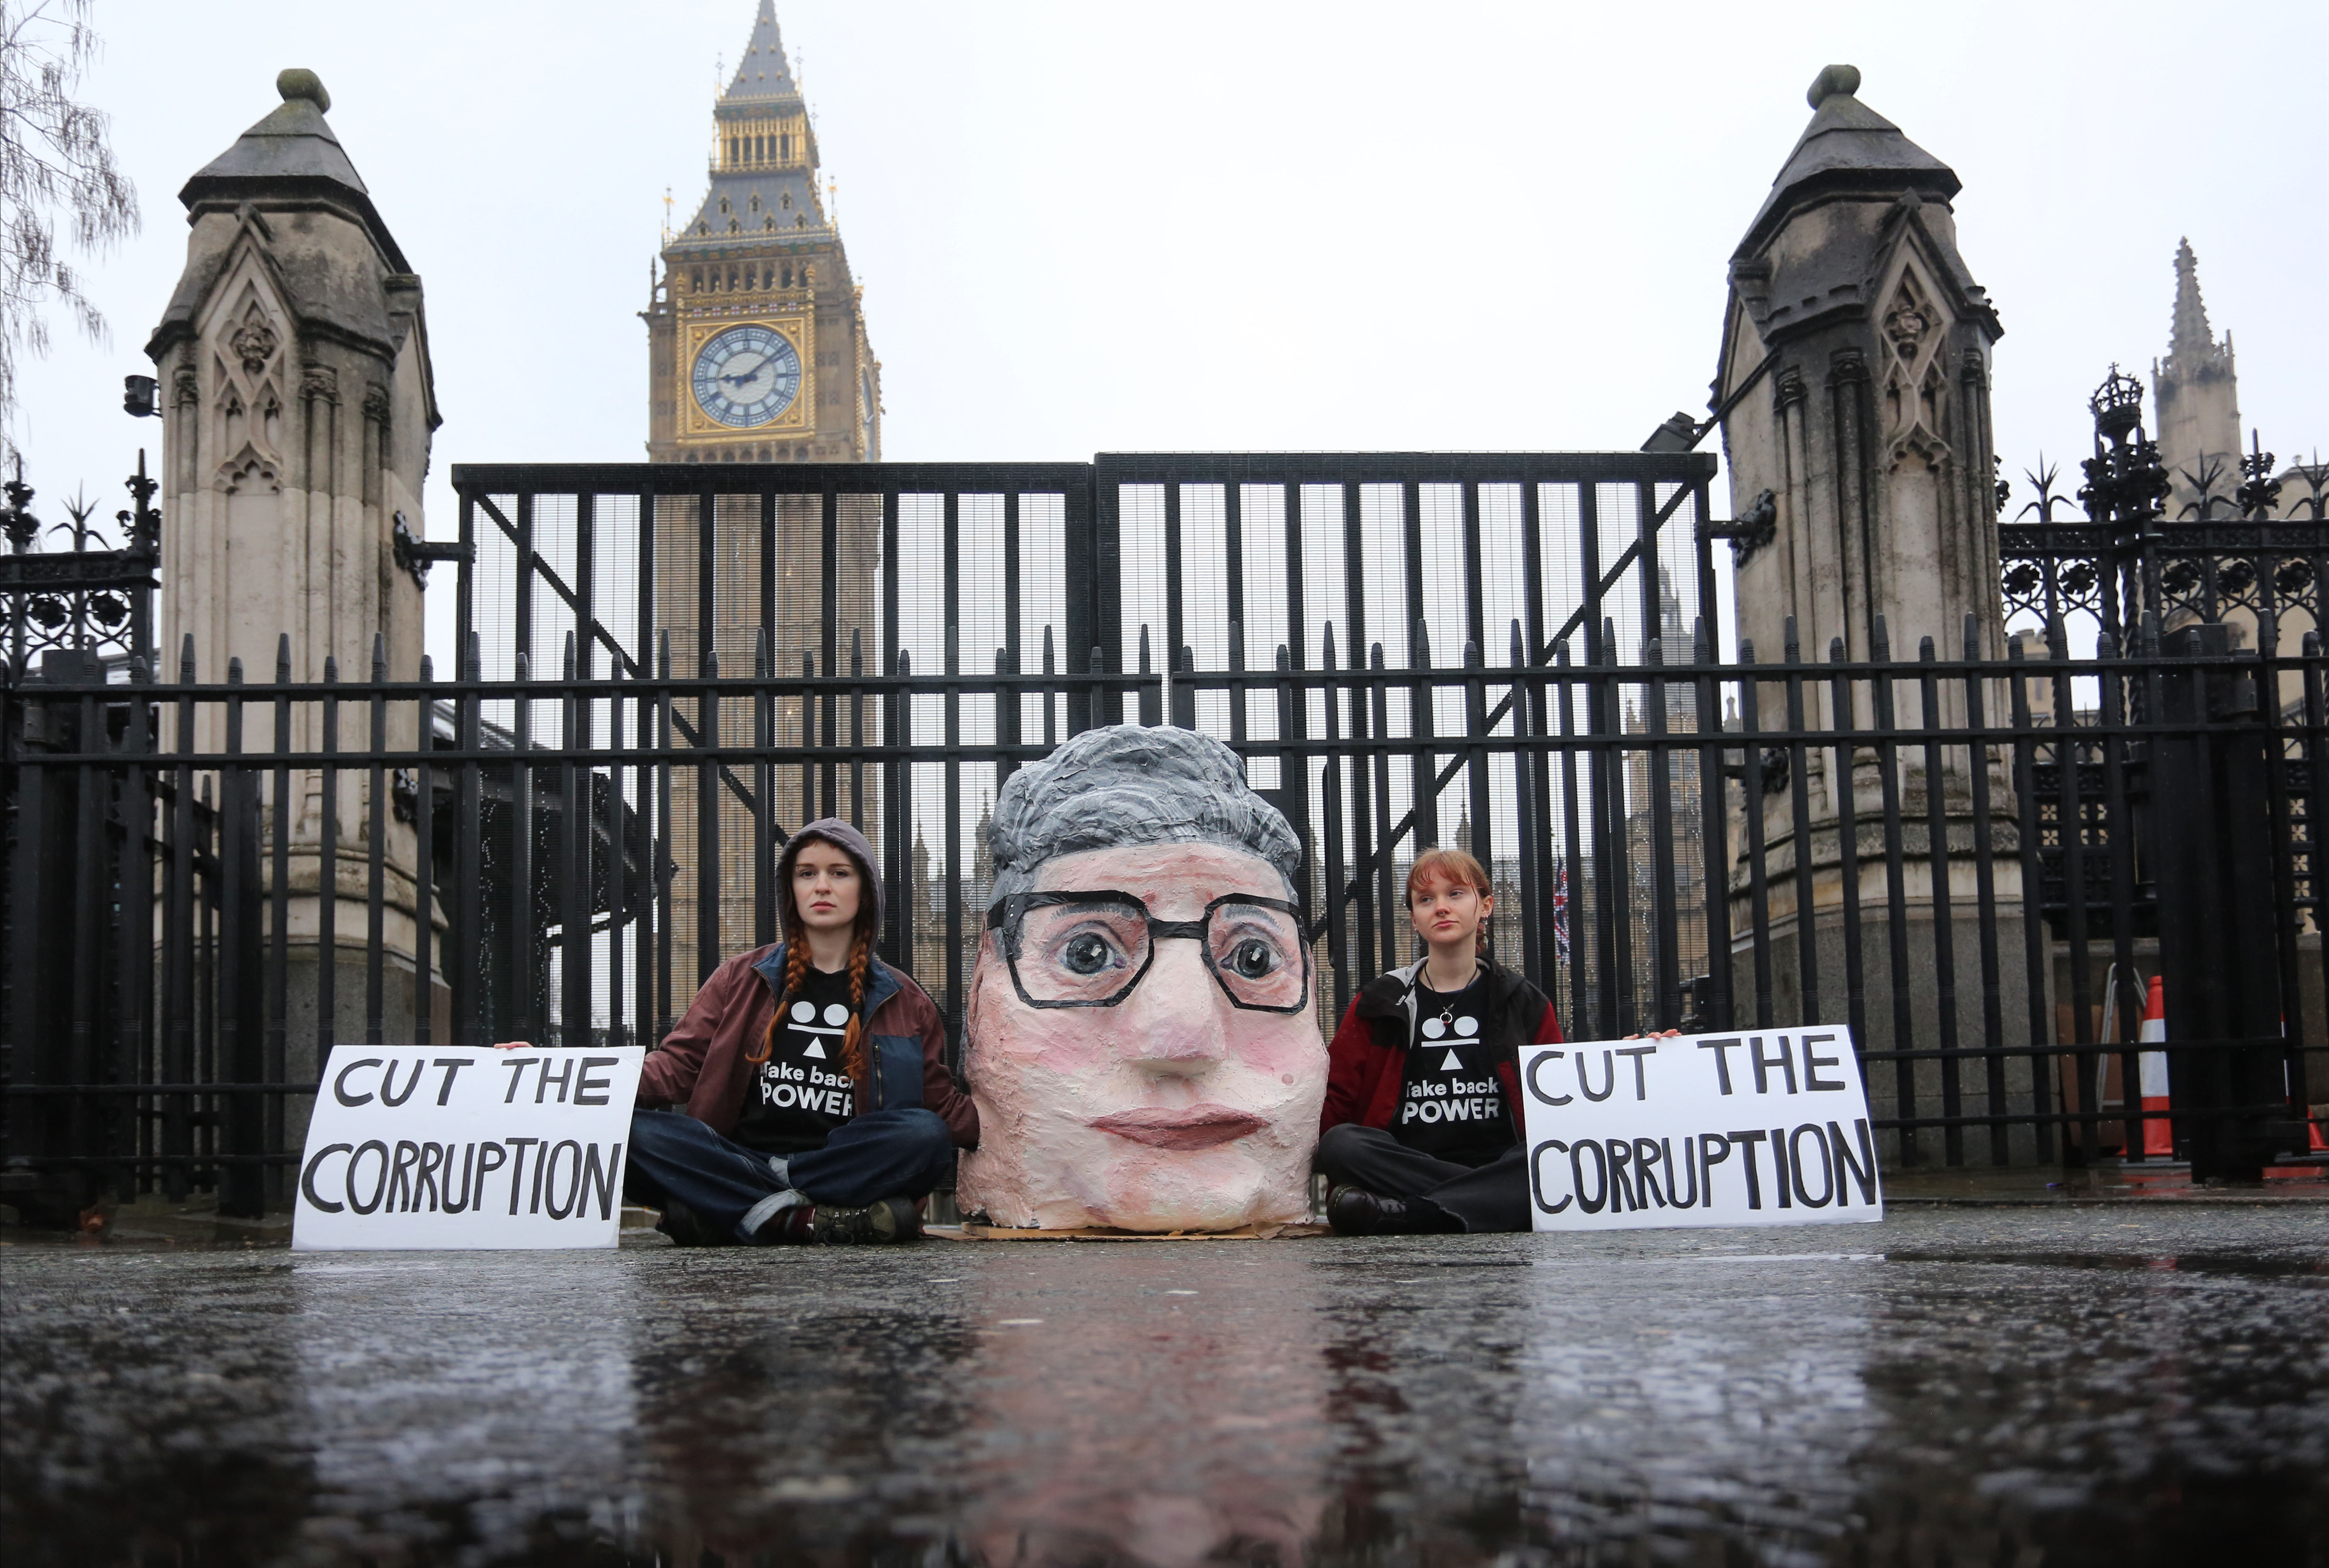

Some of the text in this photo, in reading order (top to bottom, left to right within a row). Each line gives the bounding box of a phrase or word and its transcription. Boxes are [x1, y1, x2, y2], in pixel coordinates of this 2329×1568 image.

[334, 1057, 619, 1107] CUT THE
[1452, 1077, 1499, 1095] back
[1526, 1034, 1846, 1106] CUT THE
[1402, 1098, 1500, 1124] POWER
[301, 1137, 622, 1220] CORRUPTION
[1530, 1118, 1877, 1215] CORRUPTION
